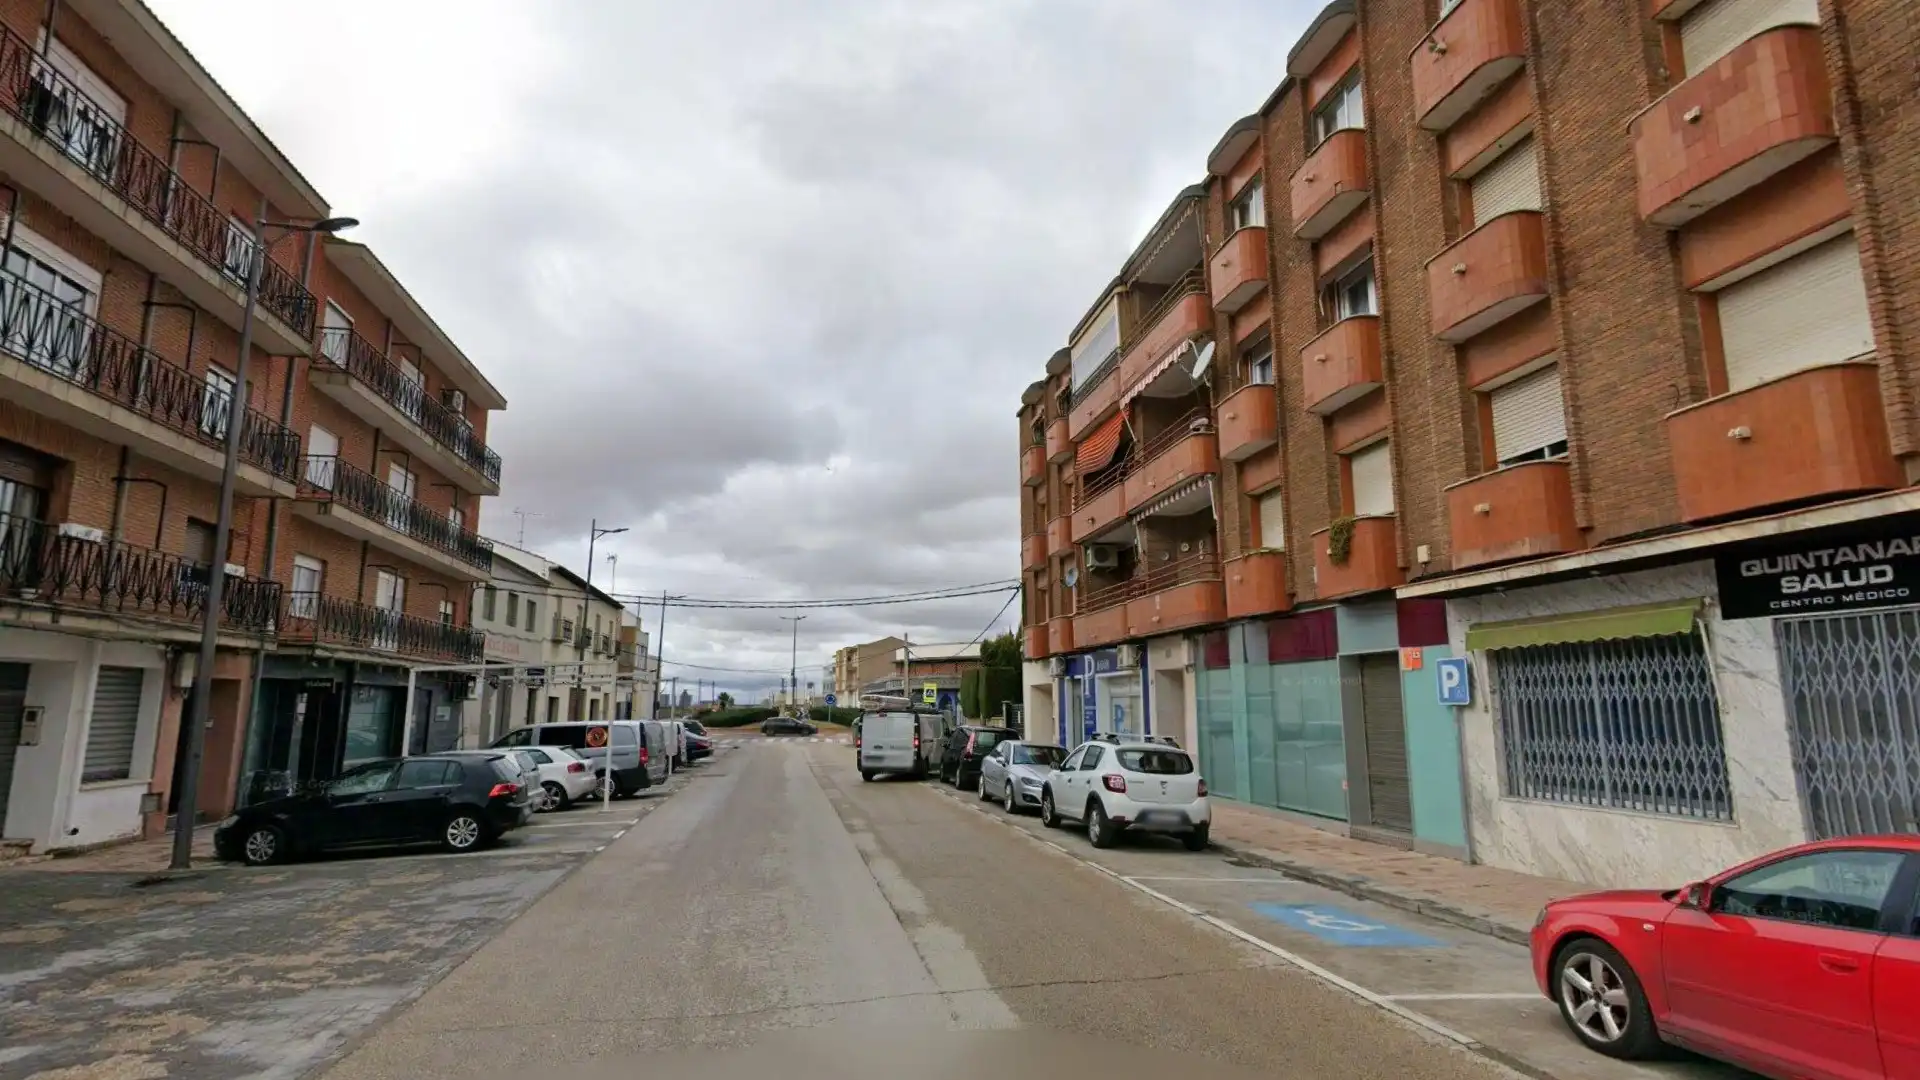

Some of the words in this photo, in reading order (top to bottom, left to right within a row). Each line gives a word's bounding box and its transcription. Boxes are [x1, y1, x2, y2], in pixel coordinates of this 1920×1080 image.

[1780, 564, 1894, 594] SALUD
[1769, 595, 1835, 609] CENTRO
[1440, 664, 1460, 699] P
